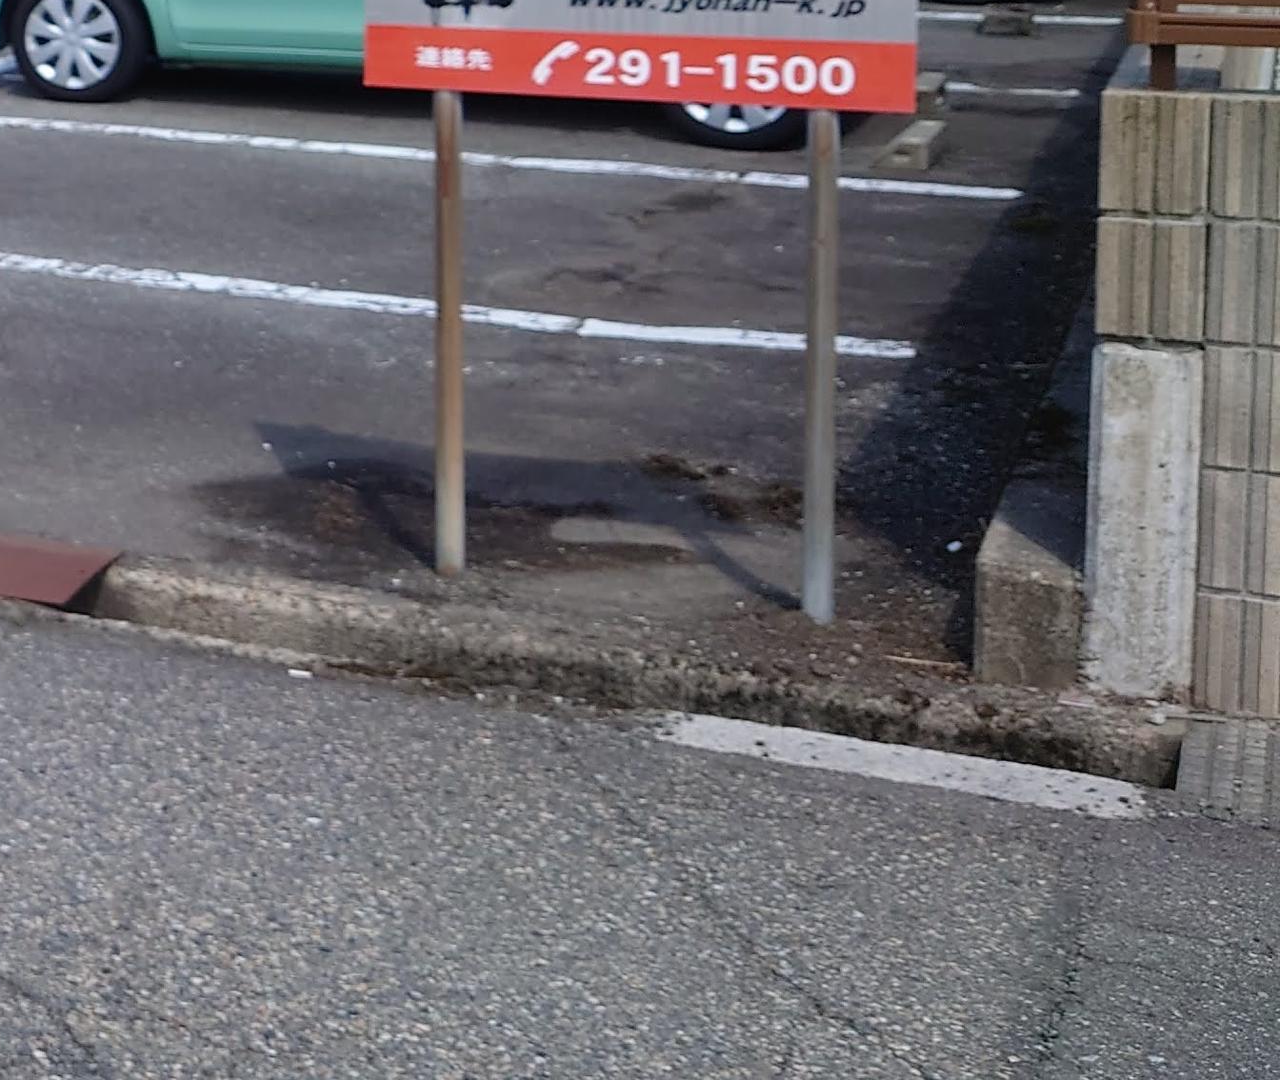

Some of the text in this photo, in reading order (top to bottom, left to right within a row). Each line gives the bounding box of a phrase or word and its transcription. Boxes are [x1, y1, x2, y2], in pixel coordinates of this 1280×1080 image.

[414, 45, 494, 71] 連絡先
[583, 47, 856, 95] 291-1500
